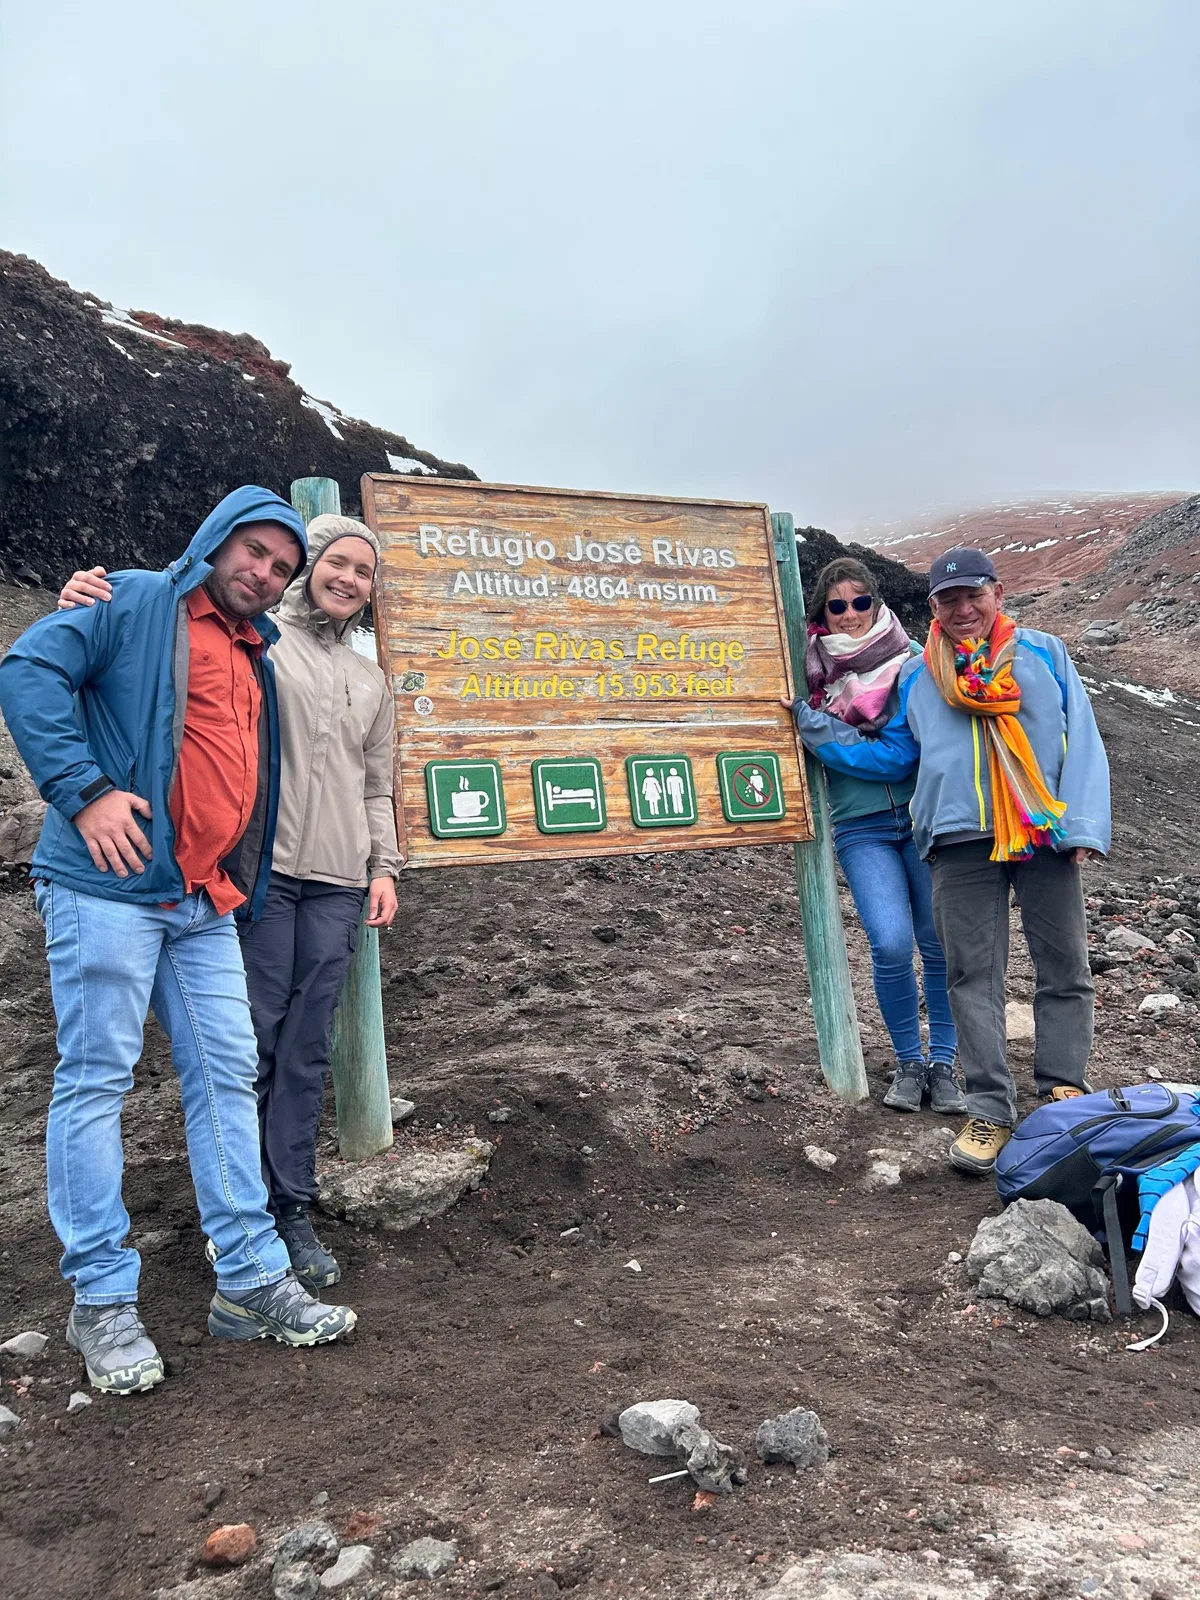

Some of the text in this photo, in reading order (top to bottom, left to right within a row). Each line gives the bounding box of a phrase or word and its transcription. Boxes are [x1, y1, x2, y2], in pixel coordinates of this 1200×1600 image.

[419, 525, 736, 568] Refugio José Rivas
[453, 570, 717, 602] Altitud: 4864 msnm
[436, 629, 744, 668] José Rivas Refuge
[460, 673, 734, 699] Altitude: 15.953 feet
